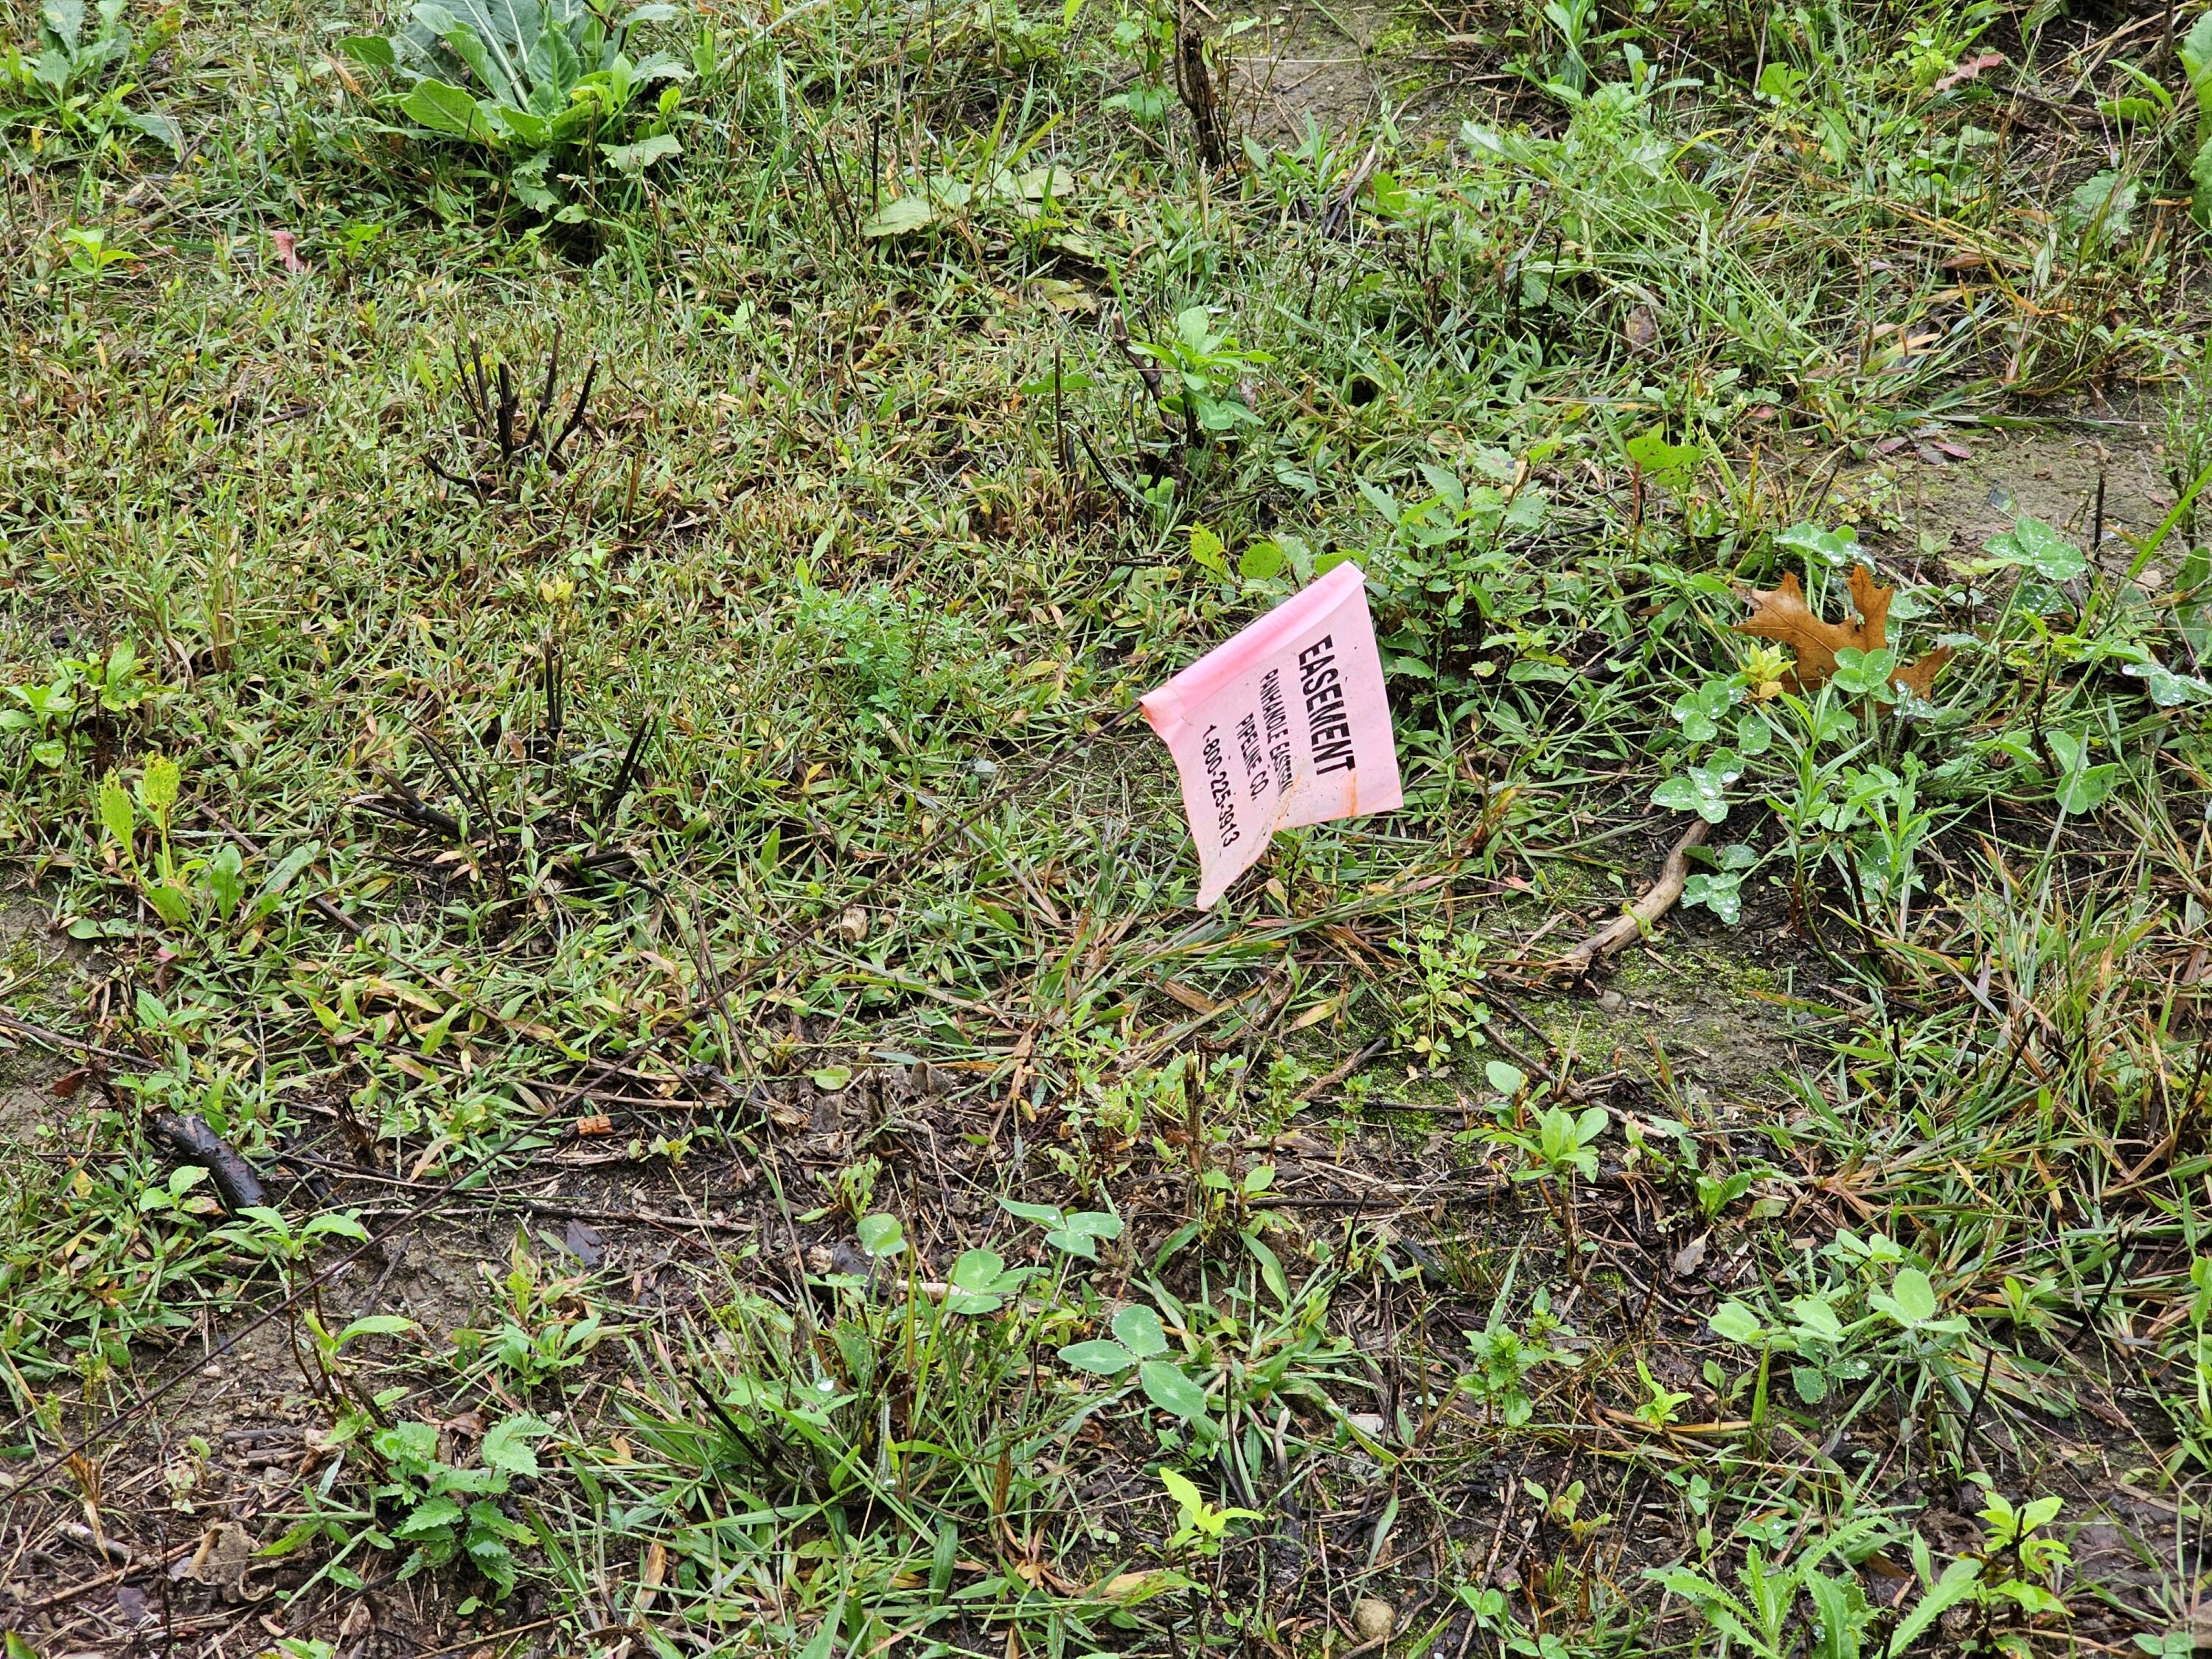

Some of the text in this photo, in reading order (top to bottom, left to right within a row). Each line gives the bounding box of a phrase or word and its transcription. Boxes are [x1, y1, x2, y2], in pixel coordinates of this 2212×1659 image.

[1235, 712, 1269, 801] PIPELINE CO.
[1259, 668, 1293, 796] PANHANDLE EASTERN
[1298, 634, 1356, 775] EASEMENT
[1203, 724, 1240, 848] 1-800-225-3913
